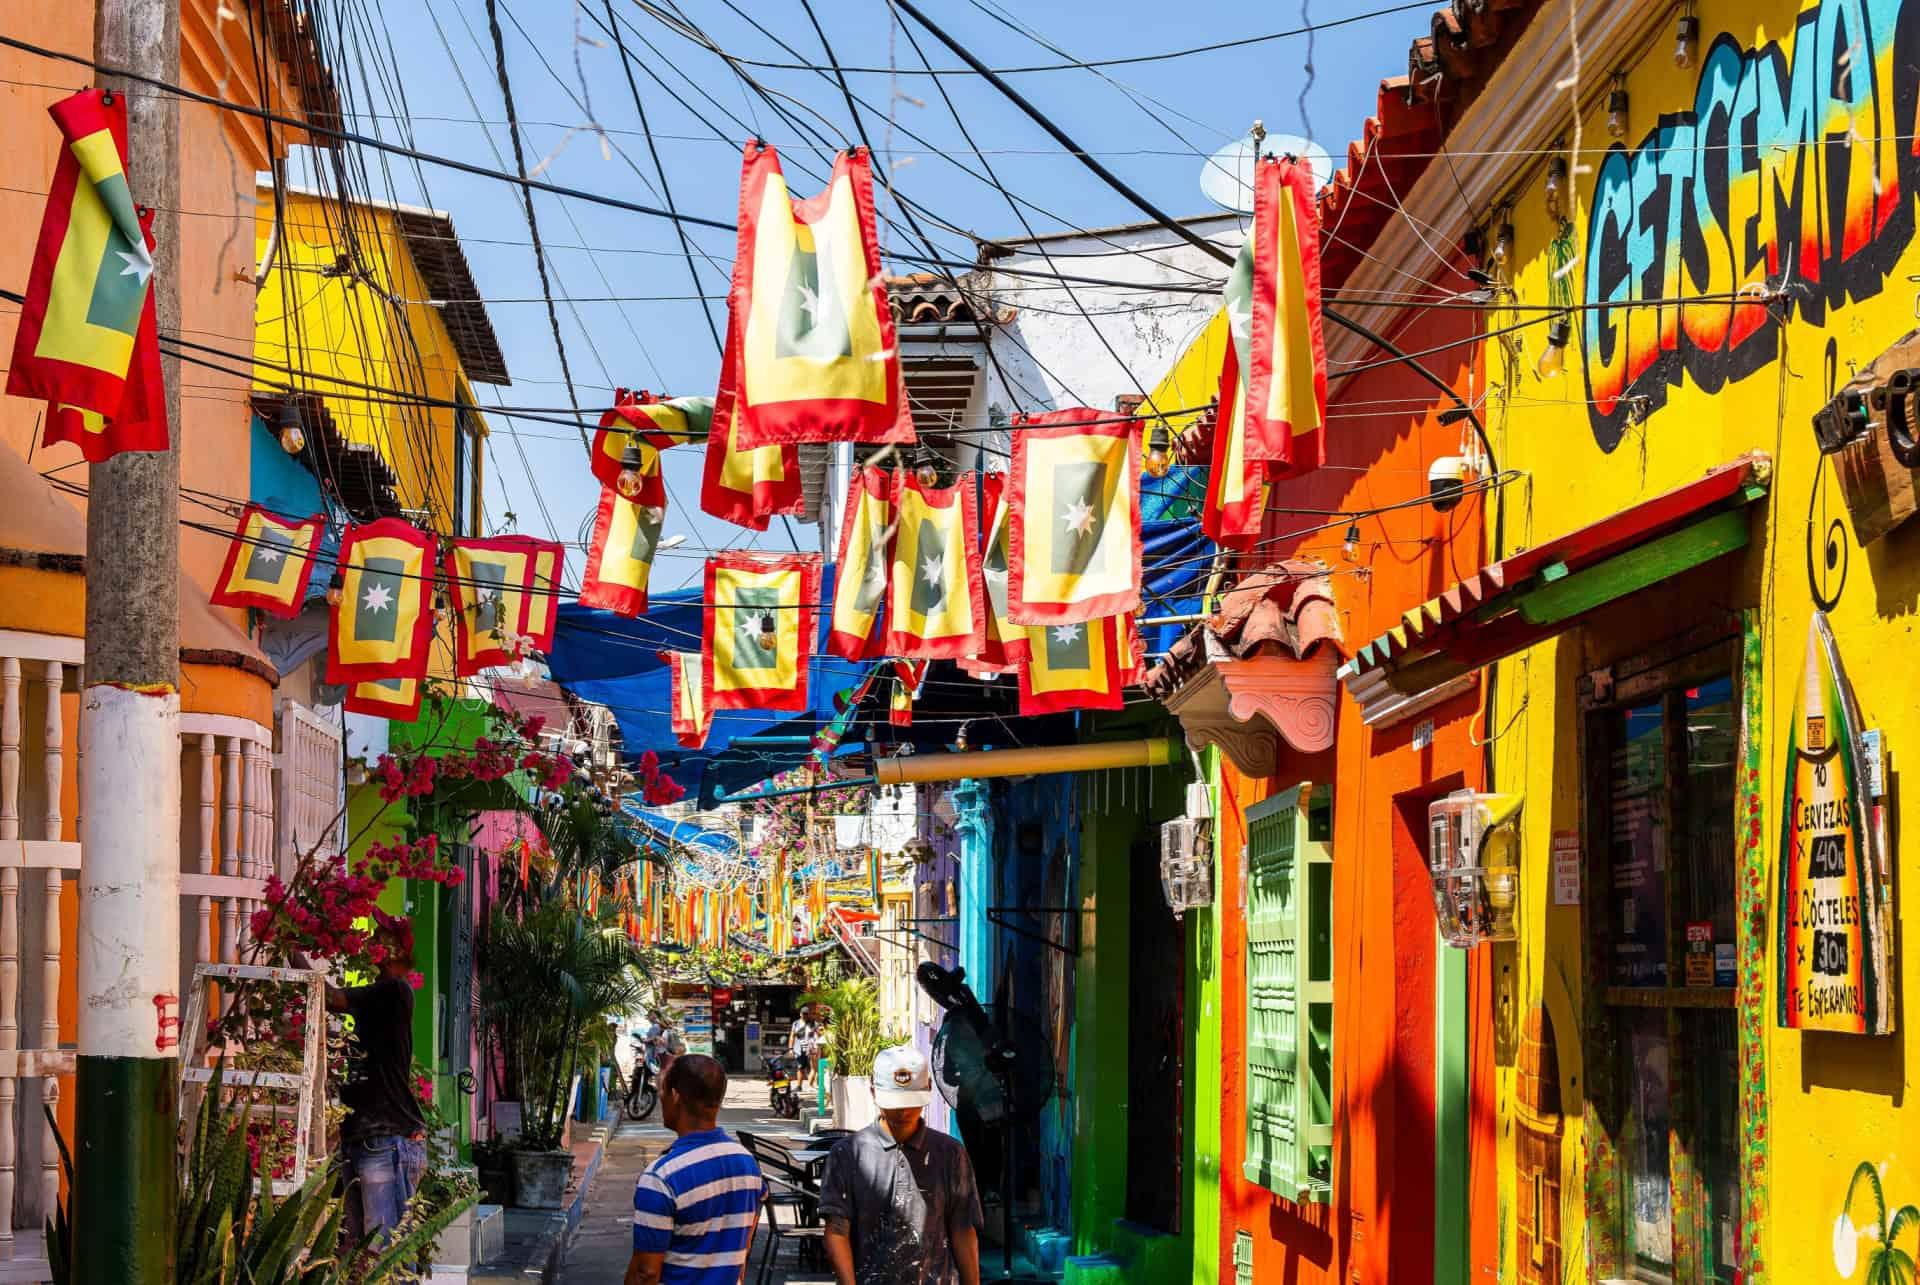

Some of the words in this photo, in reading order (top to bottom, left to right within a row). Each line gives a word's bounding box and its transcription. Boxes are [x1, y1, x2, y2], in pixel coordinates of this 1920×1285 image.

[1814, 764, 1827, 787] 10
[1796, 797, 1850, 832] CERVEZAS
[1791, 890, 1799, 927] 2
[1802, 888, 1859, 929] CÓCTELES
